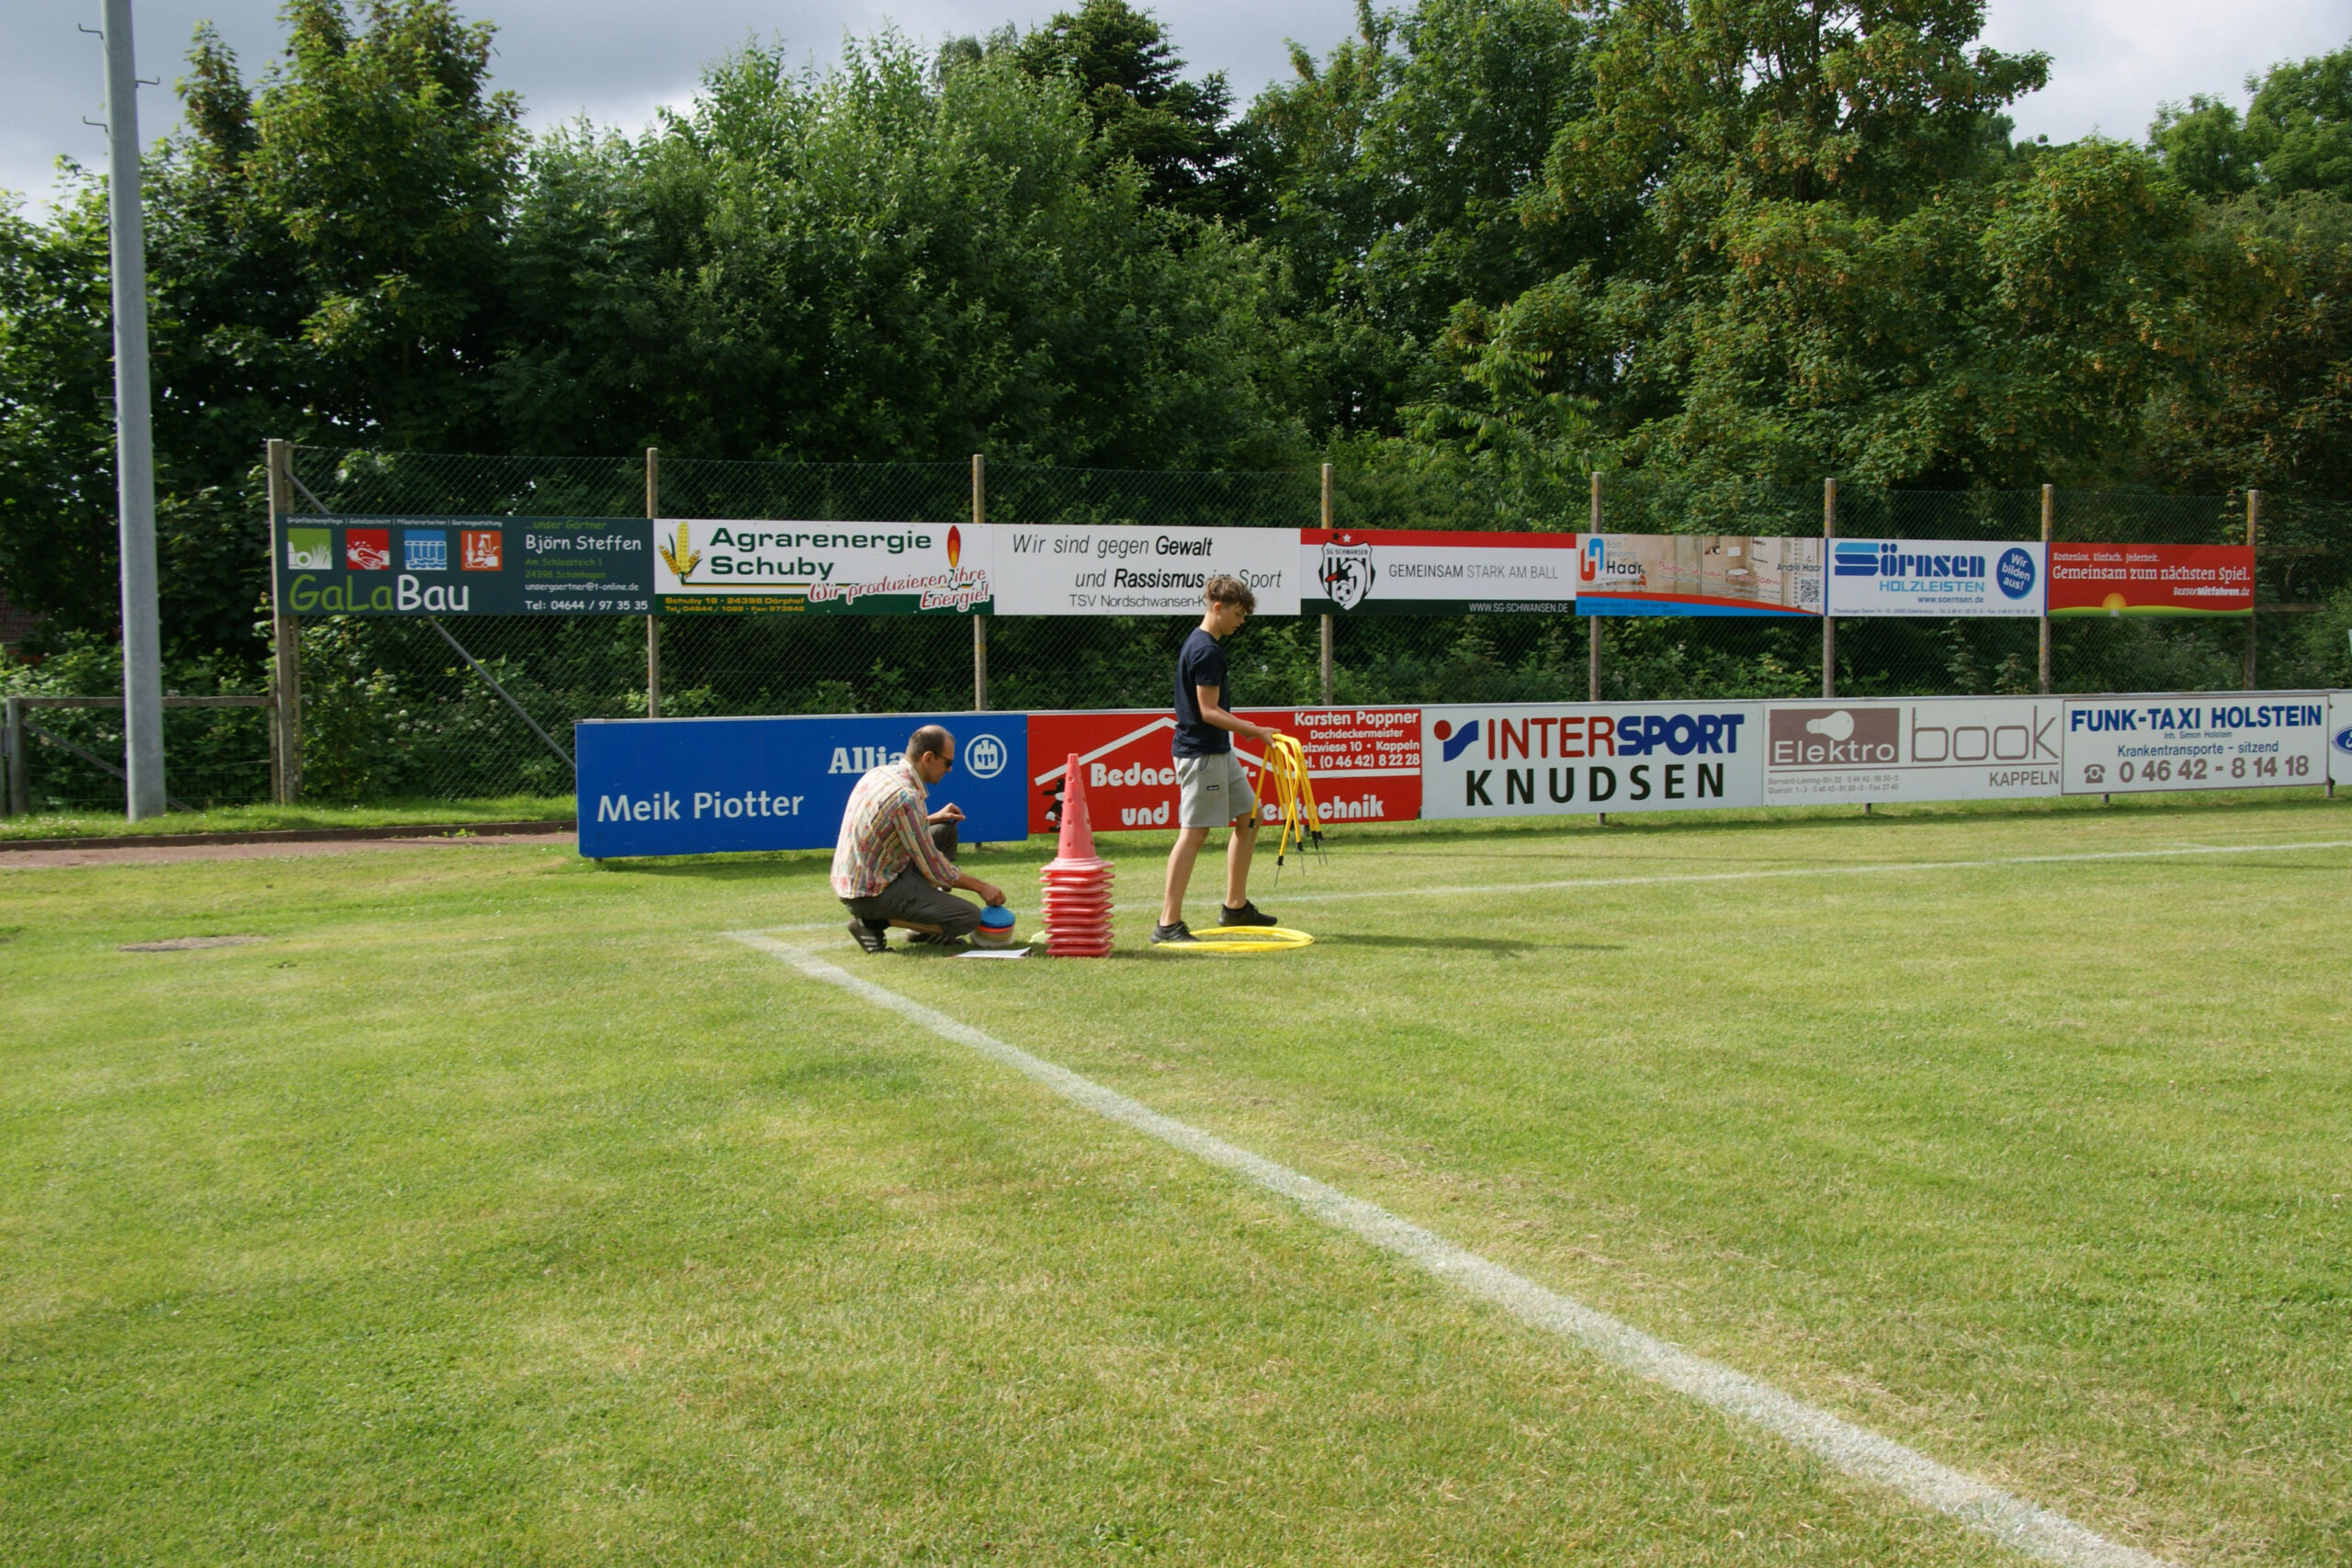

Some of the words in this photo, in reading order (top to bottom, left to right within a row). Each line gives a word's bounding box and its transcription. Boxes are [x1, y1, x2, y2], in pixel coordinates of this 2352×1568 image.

[526, 534, 571, 554] Björn
[576, 535, 641, 551] Steffen
[710, 527, 932, 552] Agrarenergie
[1012, 534, 1046, 553] Wir
[1054, 535, 1090, 554] sind
[1097, 538, 1149, 558] gegen
[1156, 536, 1213, 556] Gewalt
[710, 556, 835, 580] Schuby
[1607, 560, 1643, 575] Haar
[1803, 564, 1823, 572] Haar
[1835, 542, 1985, 578] Sörnsen
[2011, 553, 2028, 568] Wir
[1075, 569, 1107, 587] und
[1114, 569, 1205, 588] Rassismus
[1238, 569, 1282, 591] Sport
[1389, 564, 1464, 578] GEMEINSAM
[1467, 565, 1505, 579] STARK
[1509, 566, 1527, 579] AM
[1532, 566, 1558, 580] BALL
[2002, 562, 2030, 581] bilden
[2052, 565, 2127, 580] Gemeinsam
[2131, 568, 2157, 580] zum
[2160, 565, 2216, 581] nächsten
[2219, 566, 2250, 583] Spiel.
[289, 573, 469, 612] GaLaBau
[809, 581, 842, 600] Wir
[847, 574, 947, 604] produzieren
[1880, 581, 1984, 592] HOLZLEISTEN
[2003, 577, 2024, 591] aus!
[525, 600, 547, 610] Tel:
[550, 600, 585, 611] 04644
[598, 600, 613, 610] 97
[616, 600, 630, 610] 35
[634, 600, 649, 611] 35
[664, 597, 703, 605] Schuby
[921, 582, 989, 612] Energie!
[1069, 594, 1096, 606] TSV
[1918, 596, 1984, 604] www.soernsen.de
[1469, 603, 1568, 614] WWW.SG-SCHWANSEN.DE
[1295, 712, 1351, 726] Karsten
[1356, 711, 1419, 728] Poppner
[2071, 706, 2200, 731] FUNK-TAXI
[2211, 705, 2322, 728] HOLSTEIN
[1310, 728, 1404, 739] Dachdeckermeister
[1487, 714, 1745, 761] INTERSPORT
[1911, 705, 2060, 762] book
[2204, 729, 2233, 739] Holstein
[1301, 742, 1347, 752] alzwiese
[1350, 741, 1363, 751] 10
[1376, 739, 1419, 752] Kappeln
[1774, 739, 1895, 763] Elektro
[2118, 743, 2223, 759] Krankentransporte
[2237, 740, 2278, 754] sitzend
[1320, 754, 1332, 769] (0
[1336, 755, 1352, 768] 46
[1354, 754, 1374, 768] 42)
[1379, 754, 1386, 766] 8
[1388, 754, 1403, 766] 22
[1405, 754, 1420, 766] 28
[2120, 761, 2134, 783] 0
[2142, 760, 2171, 782] 46
[2177, 758, 2207, 780] 42
[2231, 757, 2245, 779] 8
[2253, 757, 2278, 778] 14
[2285, 755, 2310, 777] 18
[1465, 762, 1724, 807] KNUDSEN
[1990, 770, 2059, 786] KAPPELN
[597, 792, 681, 822] Meik
[693, 790, 804, 819] Piotter
[1121, 801, 1170, 826] und
